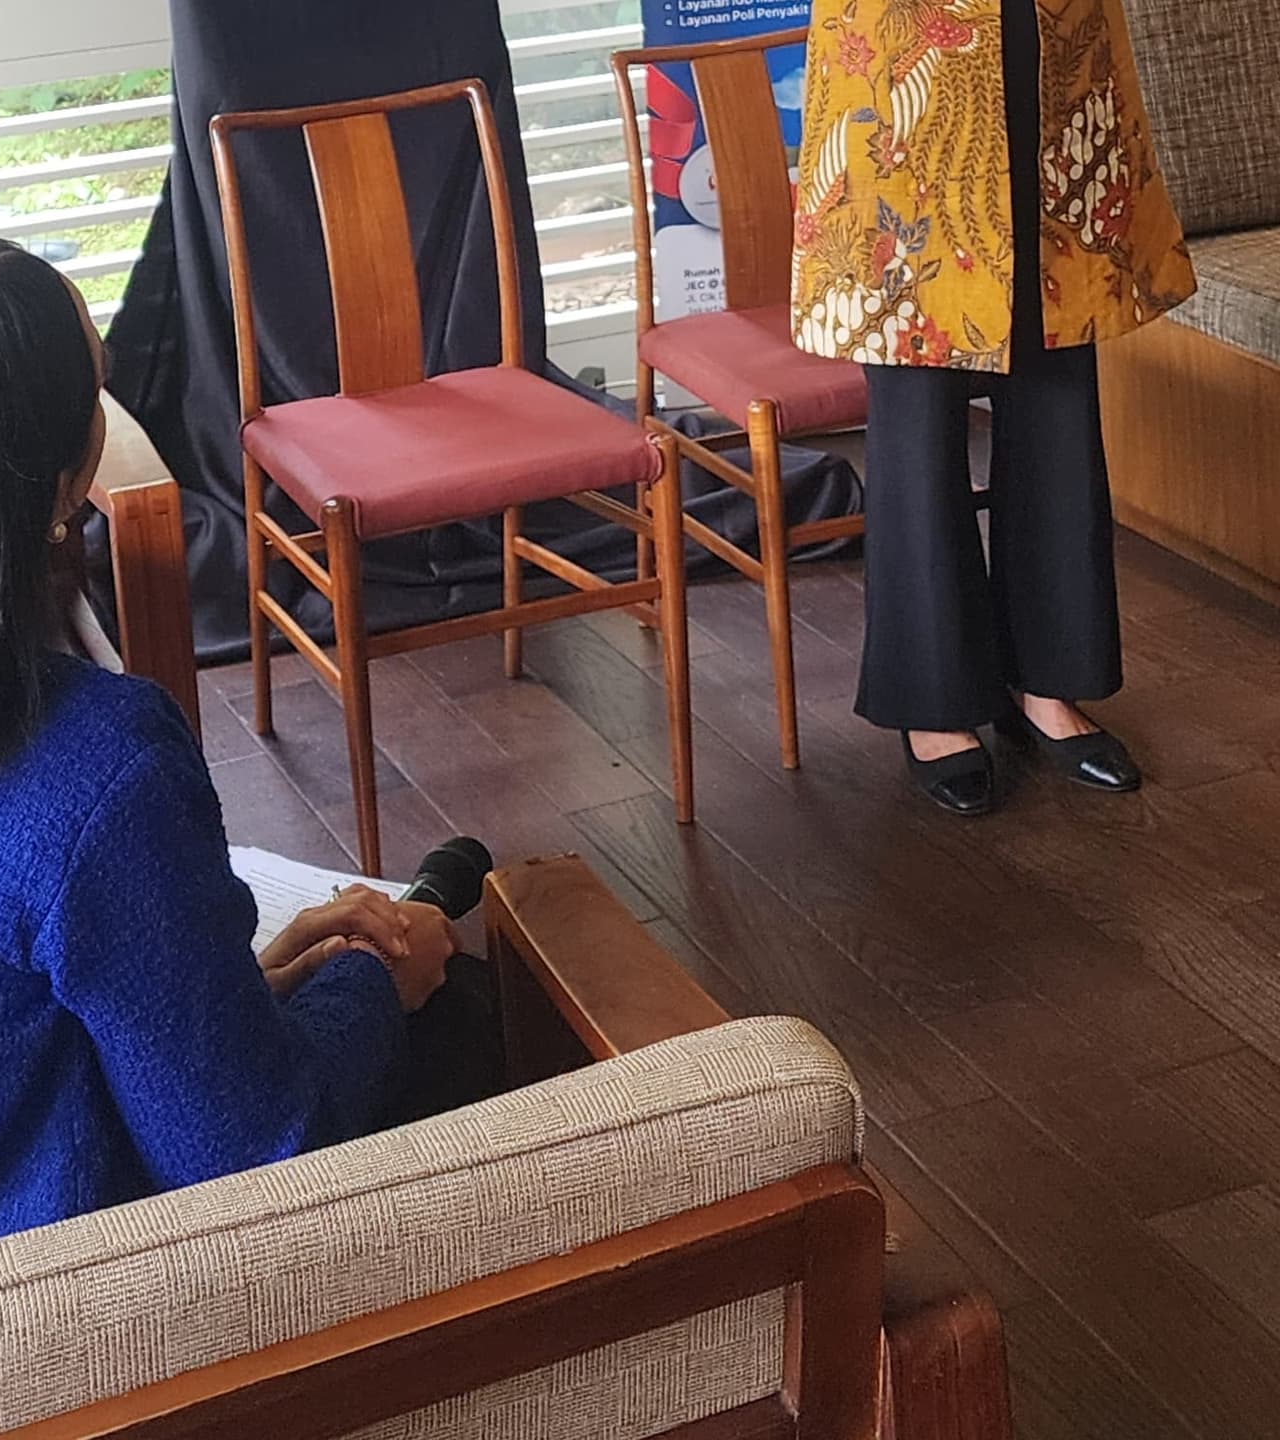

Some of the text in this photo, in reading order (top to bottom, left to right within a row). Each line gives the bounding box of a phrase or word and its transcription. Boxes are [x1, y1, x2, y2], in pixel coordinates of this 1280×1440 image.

[680, 5, 808, 28] Layanan Poli Penyakit
